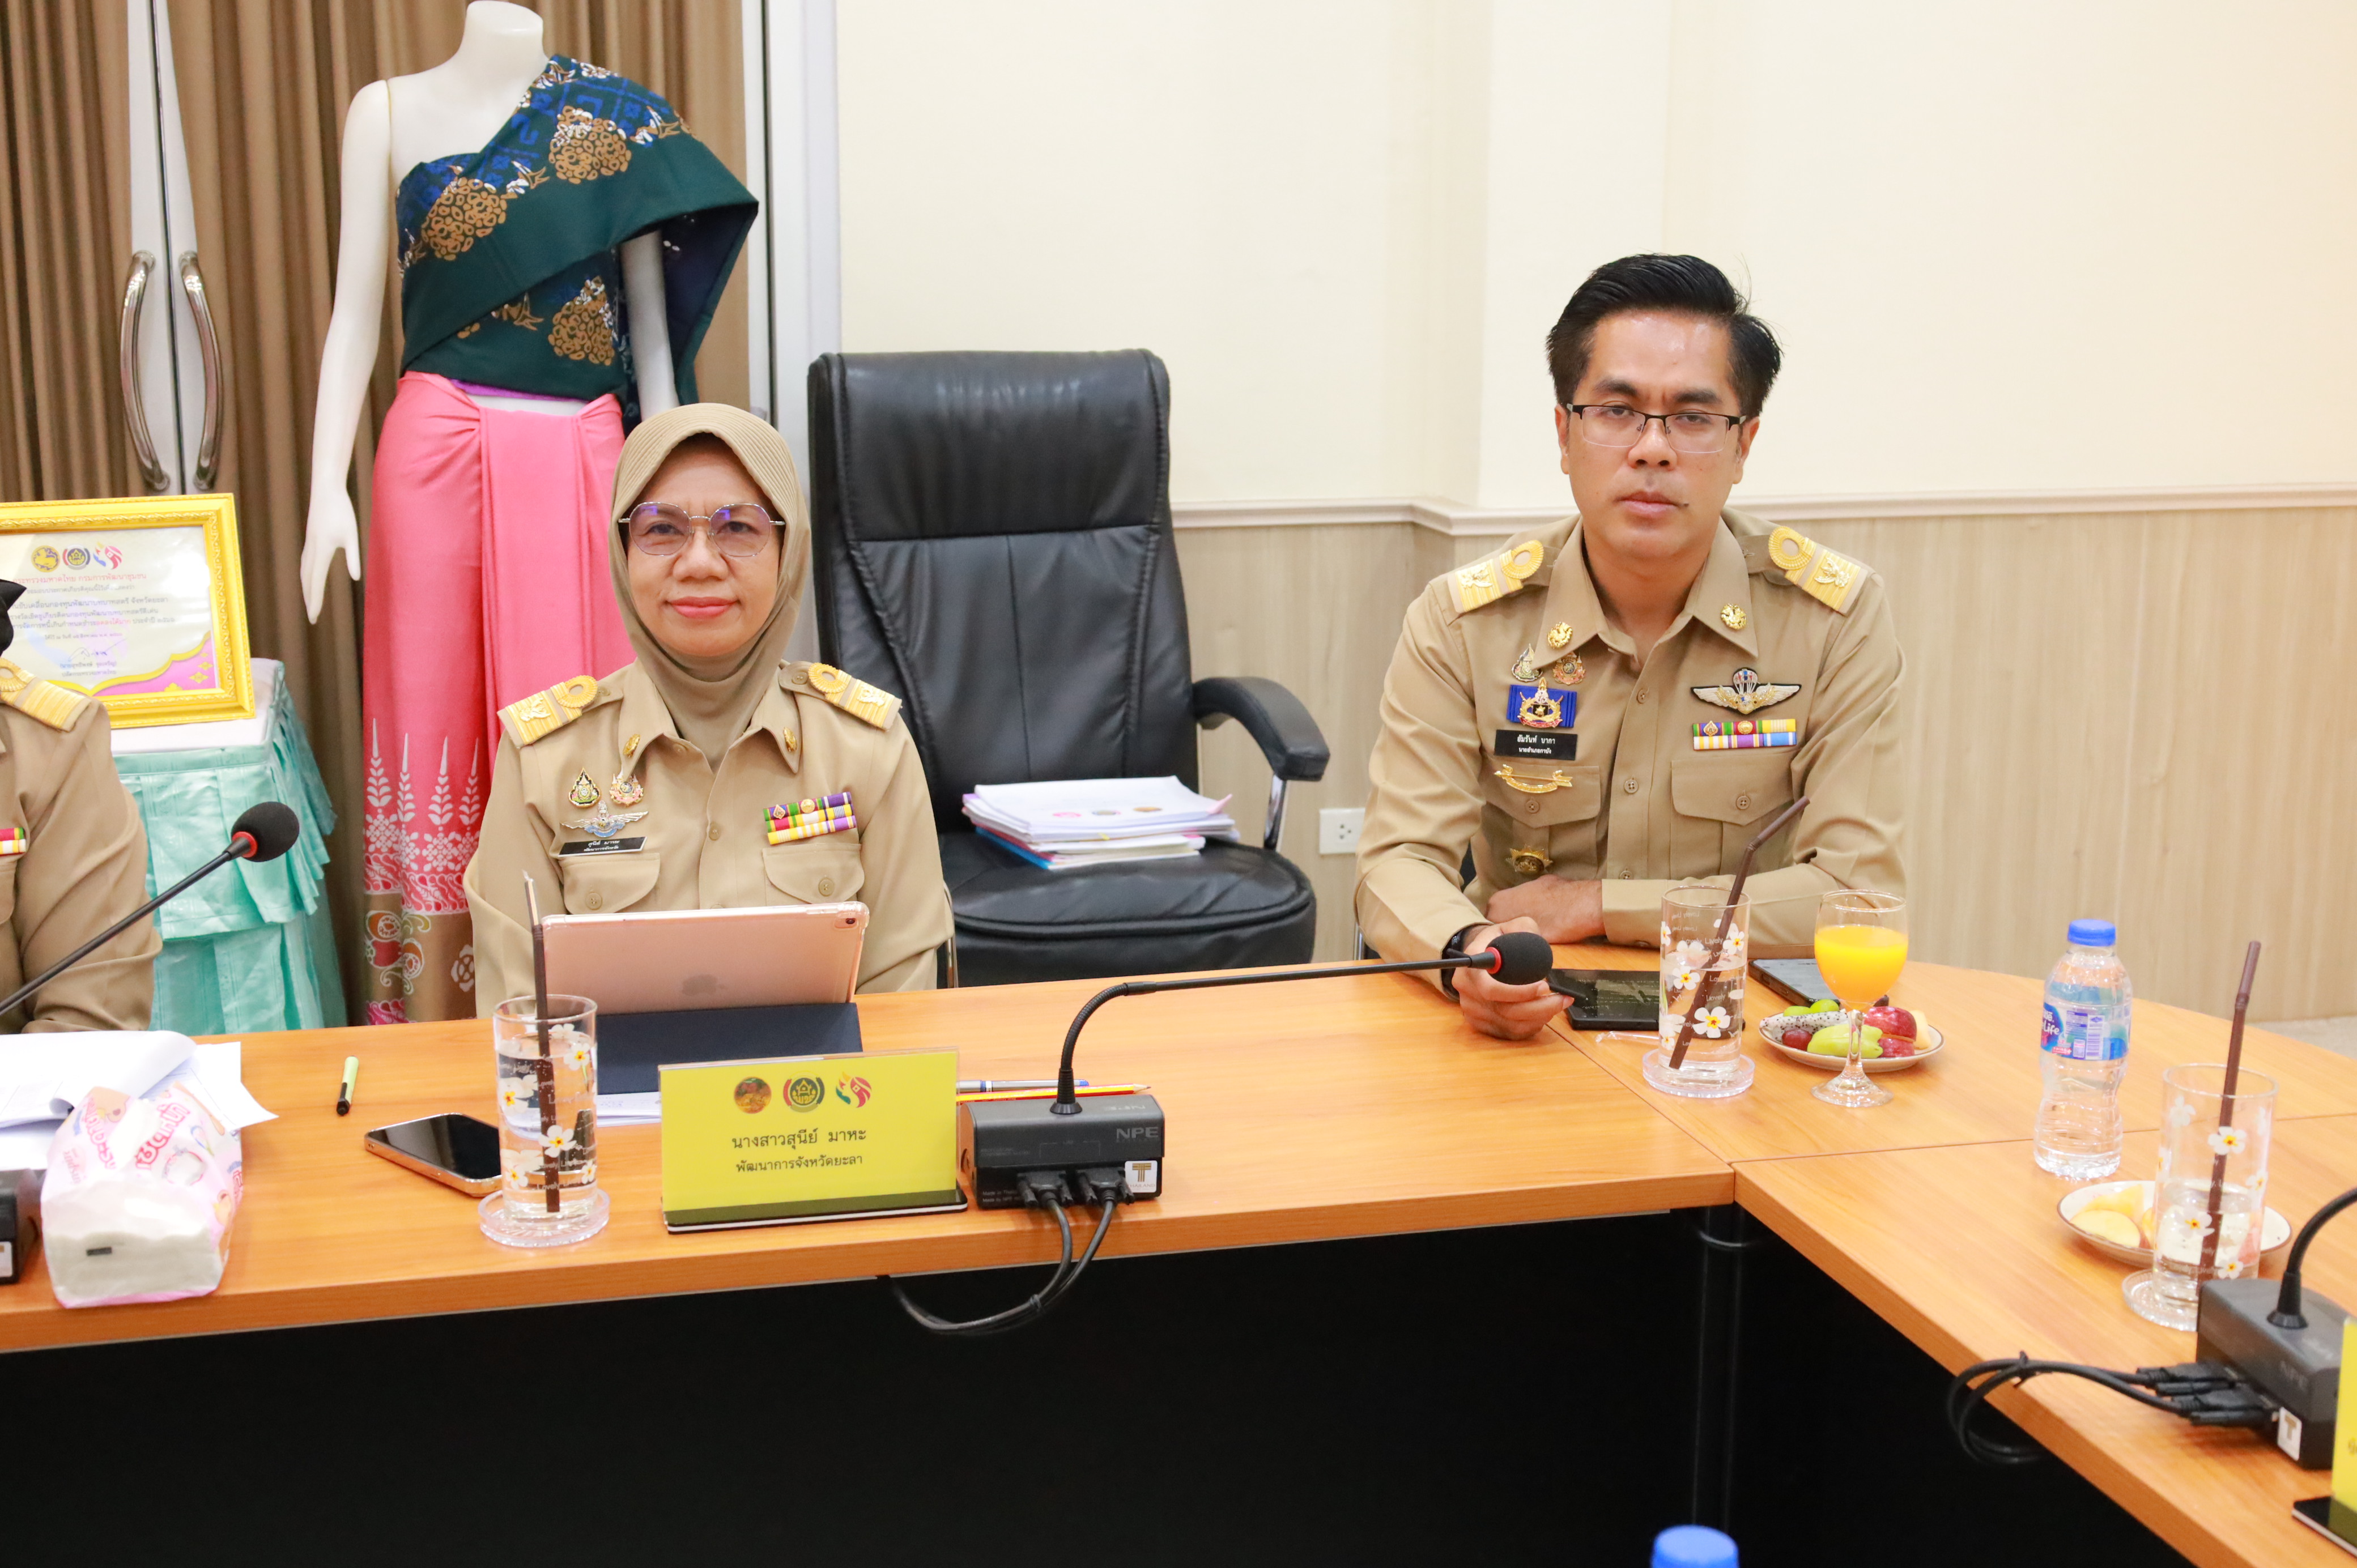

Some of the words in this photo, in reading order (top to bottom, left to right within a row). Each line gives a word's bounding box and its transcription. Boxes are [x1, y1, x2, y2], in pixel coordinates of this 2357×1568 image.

[79, 573, 147, 582] กรมการพัฒนาชุมชน
[2044, 1021, 2060, 1036] Life
[731, 1128, 819, 1150] นางสาวสุนีย์
[828, 1129, 866, 1143] มาหะ
[1116, 1126, 1159, 1140] NPE
[736, 1154, 862, 1173] พัฒนาการจังหวัดยะลา
